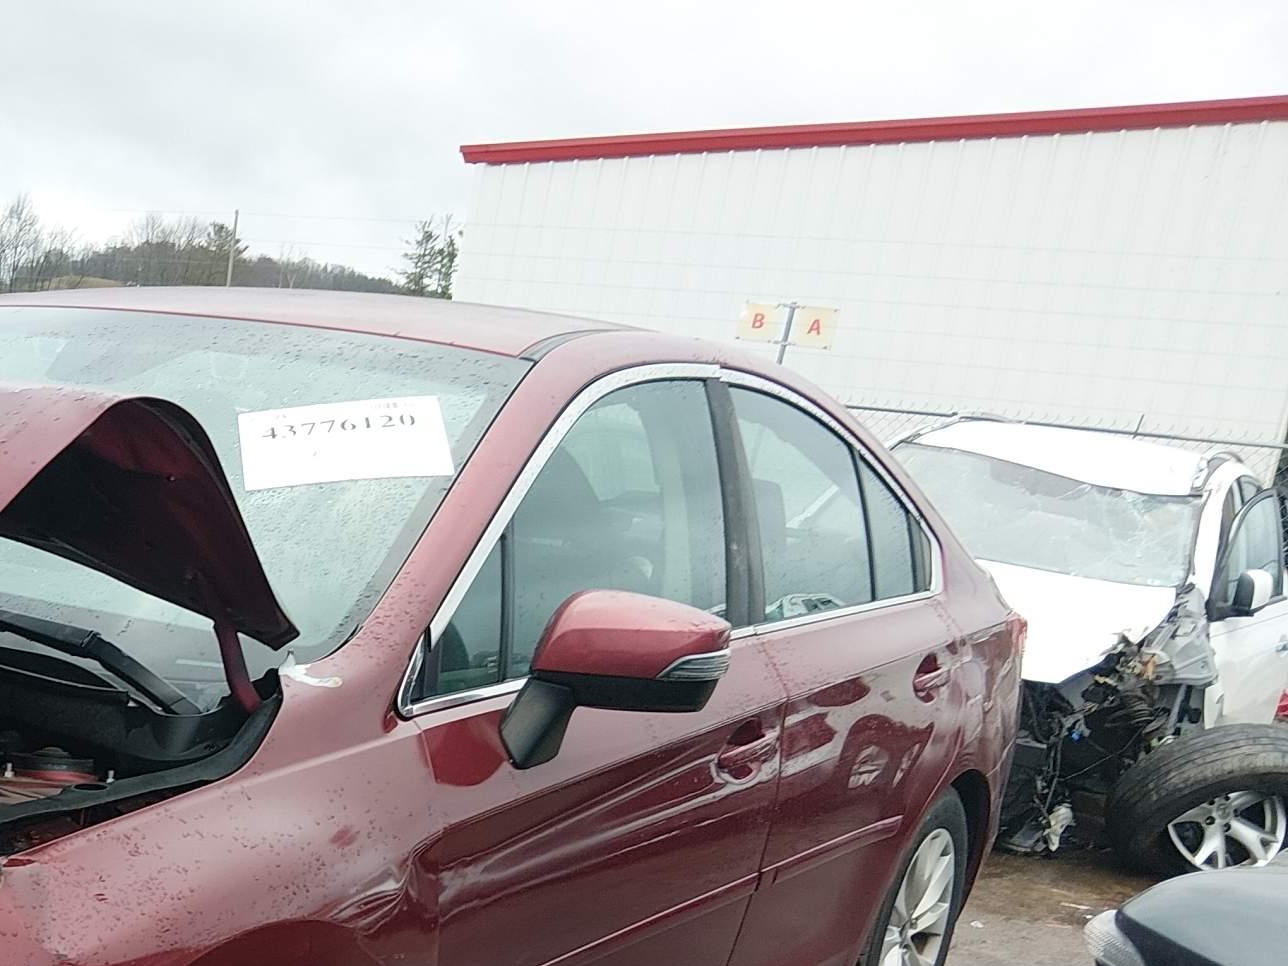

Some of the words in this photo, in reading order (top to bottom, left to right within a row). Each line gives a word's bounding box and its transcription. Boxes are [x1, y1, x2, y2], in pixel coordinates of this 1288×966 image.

[752, 313, 765, 328] B
[807, 319, 821, 335] A
[262, 414, 415, 439] 43776120
